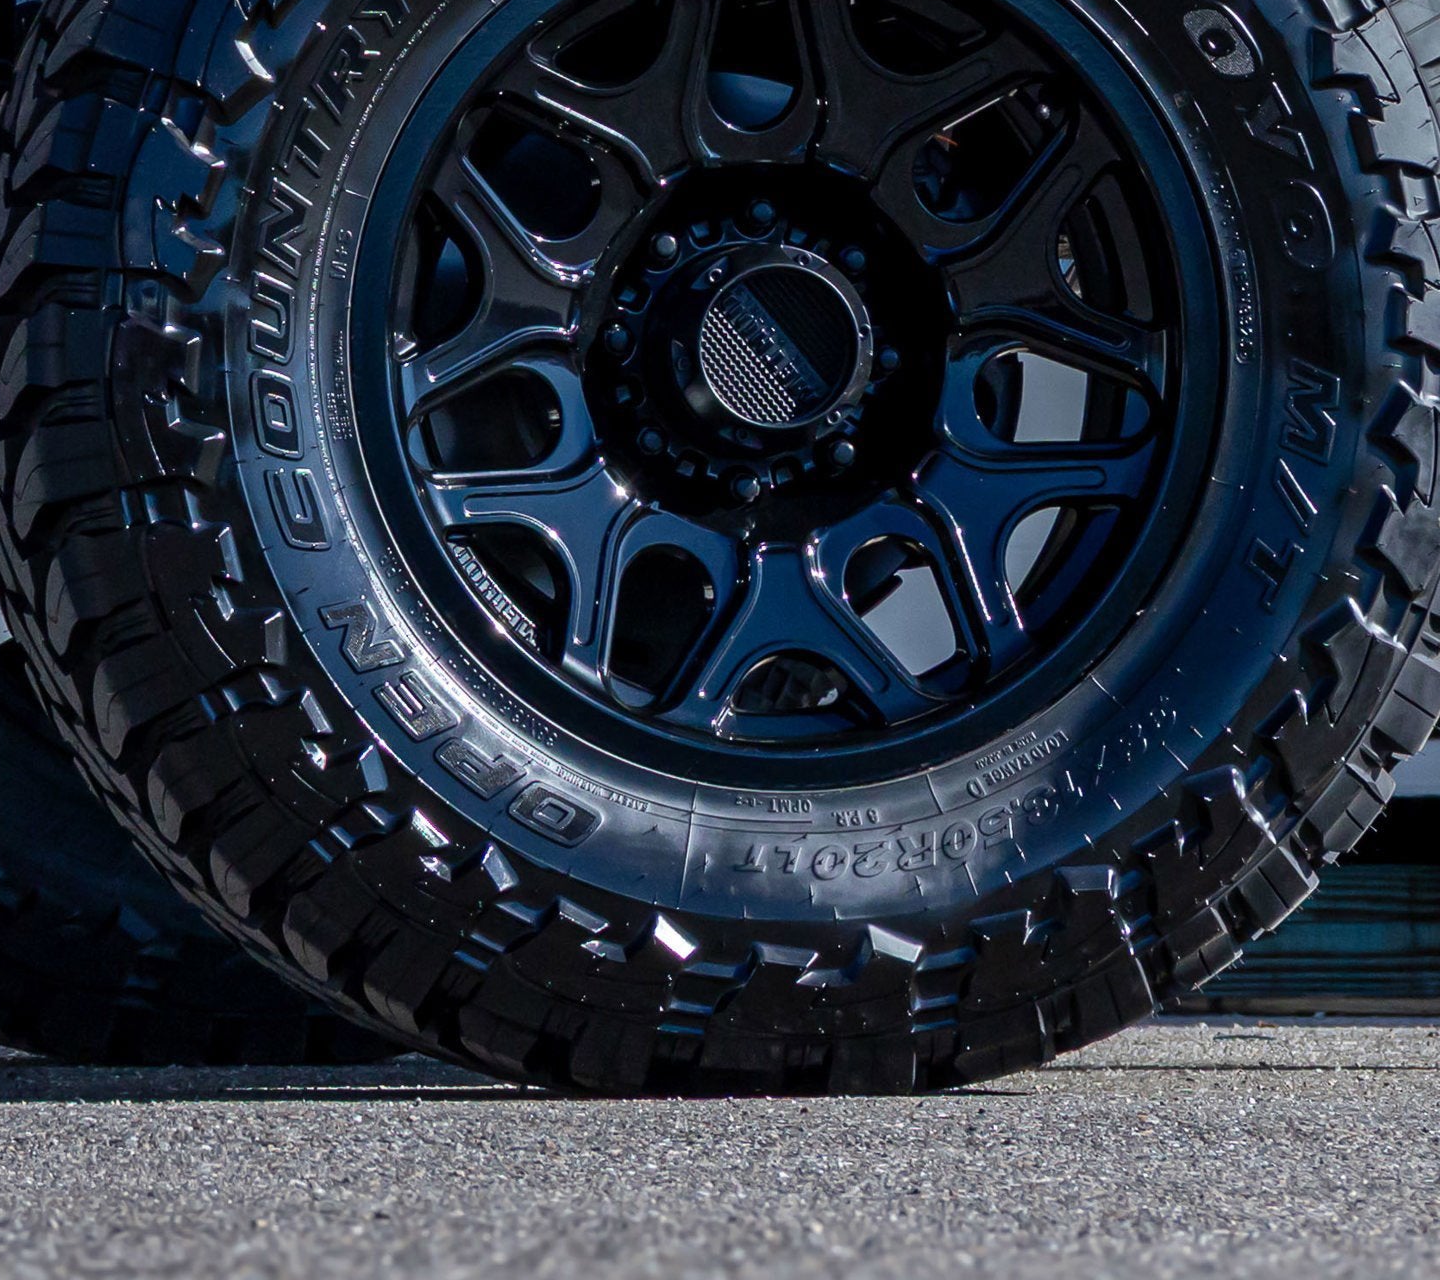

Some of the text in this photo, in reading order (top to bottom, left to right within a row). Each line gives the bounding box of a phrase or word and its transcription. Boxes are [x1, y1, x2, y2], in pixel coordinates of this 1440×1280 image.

[1244, 357, 1342, 613] M/T
[317, 597, 604, 854] OPEN
[963, 727, 1070, 801] LOAD RANGE D
